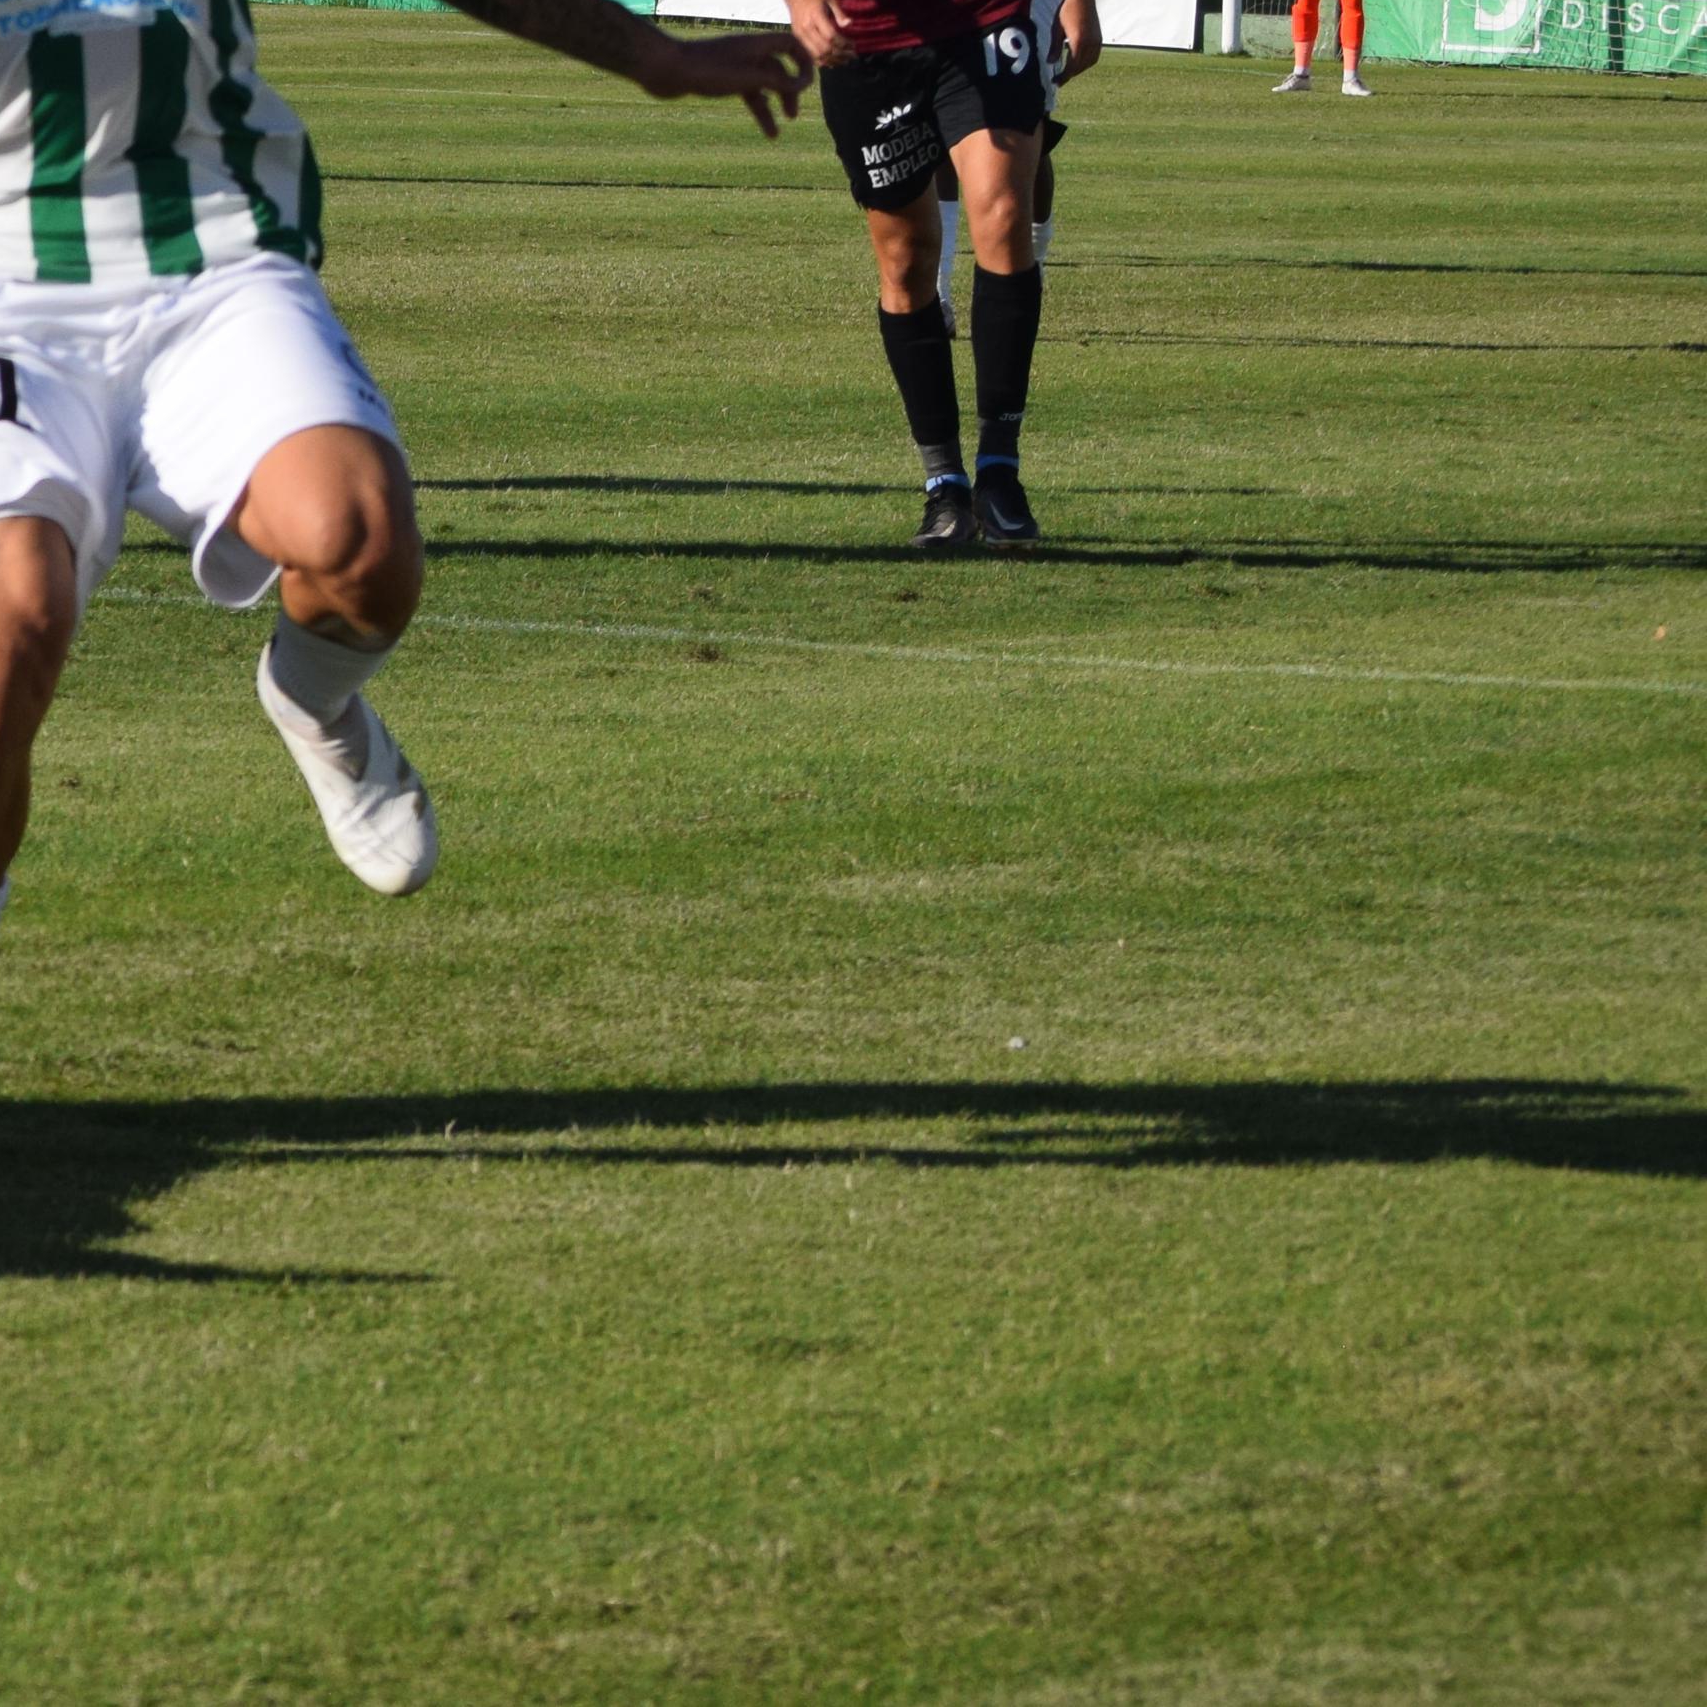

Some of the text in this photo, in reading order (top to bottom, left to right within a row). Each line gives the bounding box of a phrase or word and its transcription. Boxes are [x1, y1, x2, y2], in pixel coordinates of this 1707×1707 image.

[982, 26, 1031, 77] 19
[861, 122, 936, 166] MODERA
[867, 142, 941, 189] EMPLEO
